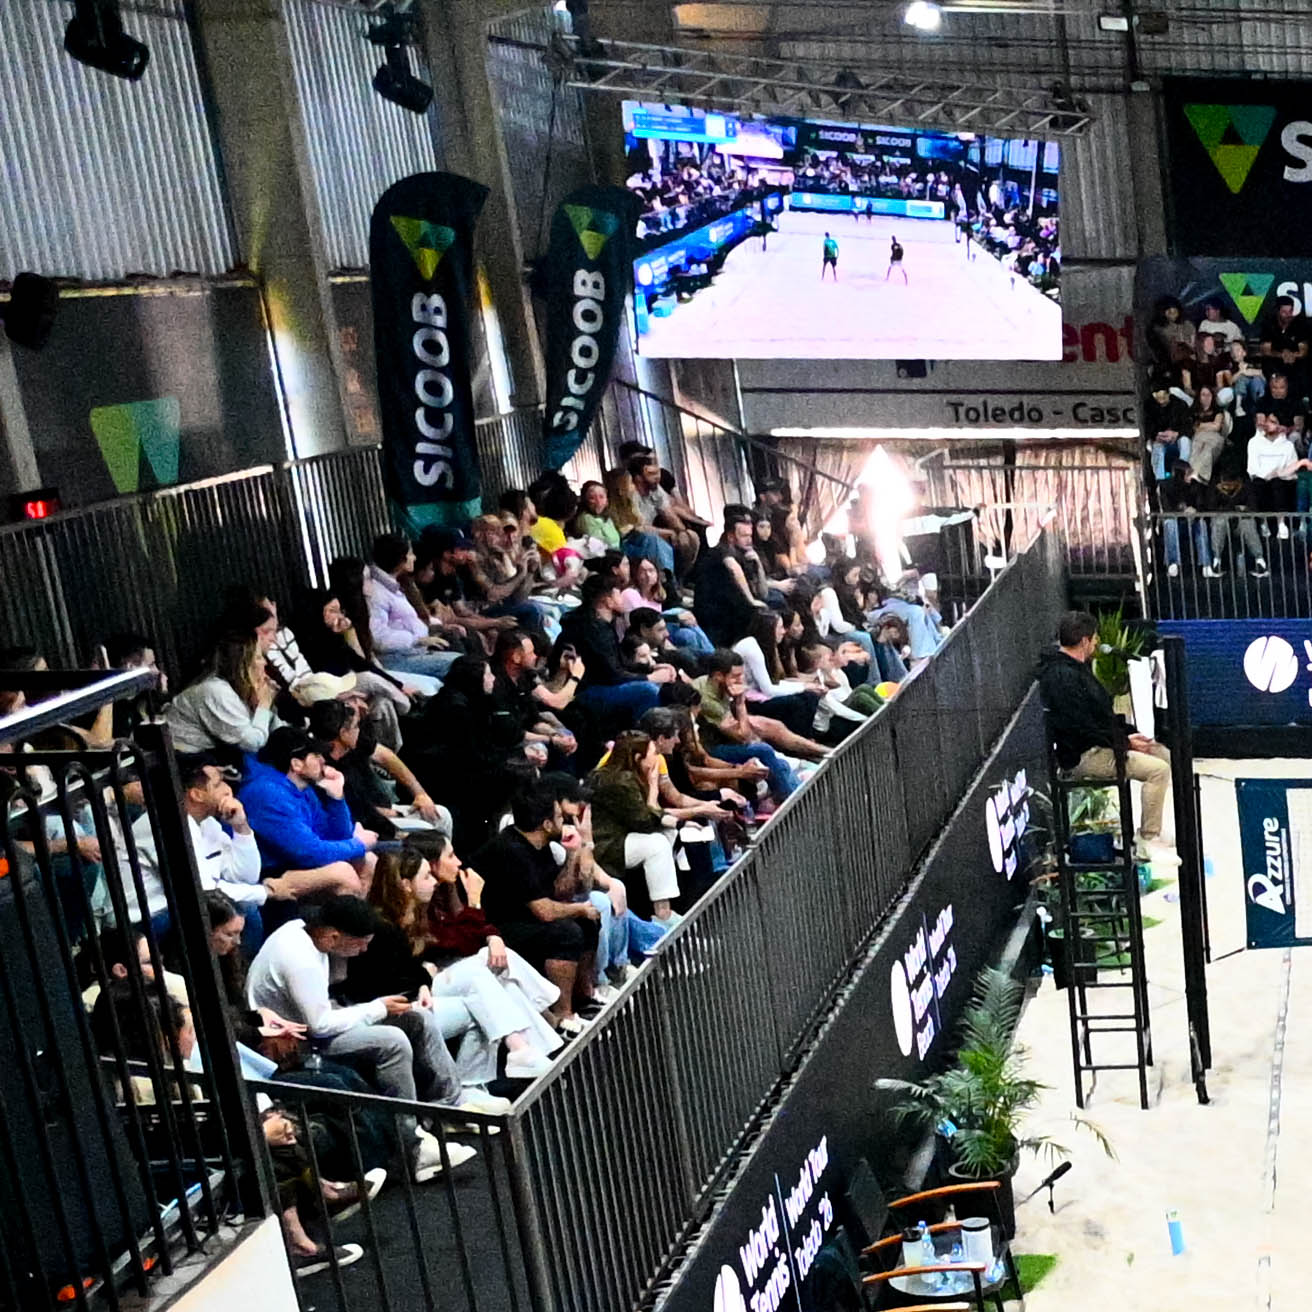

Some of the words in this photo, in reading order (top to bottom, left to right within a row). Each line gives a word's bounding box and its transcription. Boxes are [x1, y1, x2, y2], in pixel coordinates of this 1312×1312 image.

[412, 291, 454, 490] SICOOB
[552, 269, 606, 431] SICOOB
[947, 402, 1044, 424] Toledo
[1072, 402, 1136, 424] Casc
[740, 1194, 780, 1288] World
